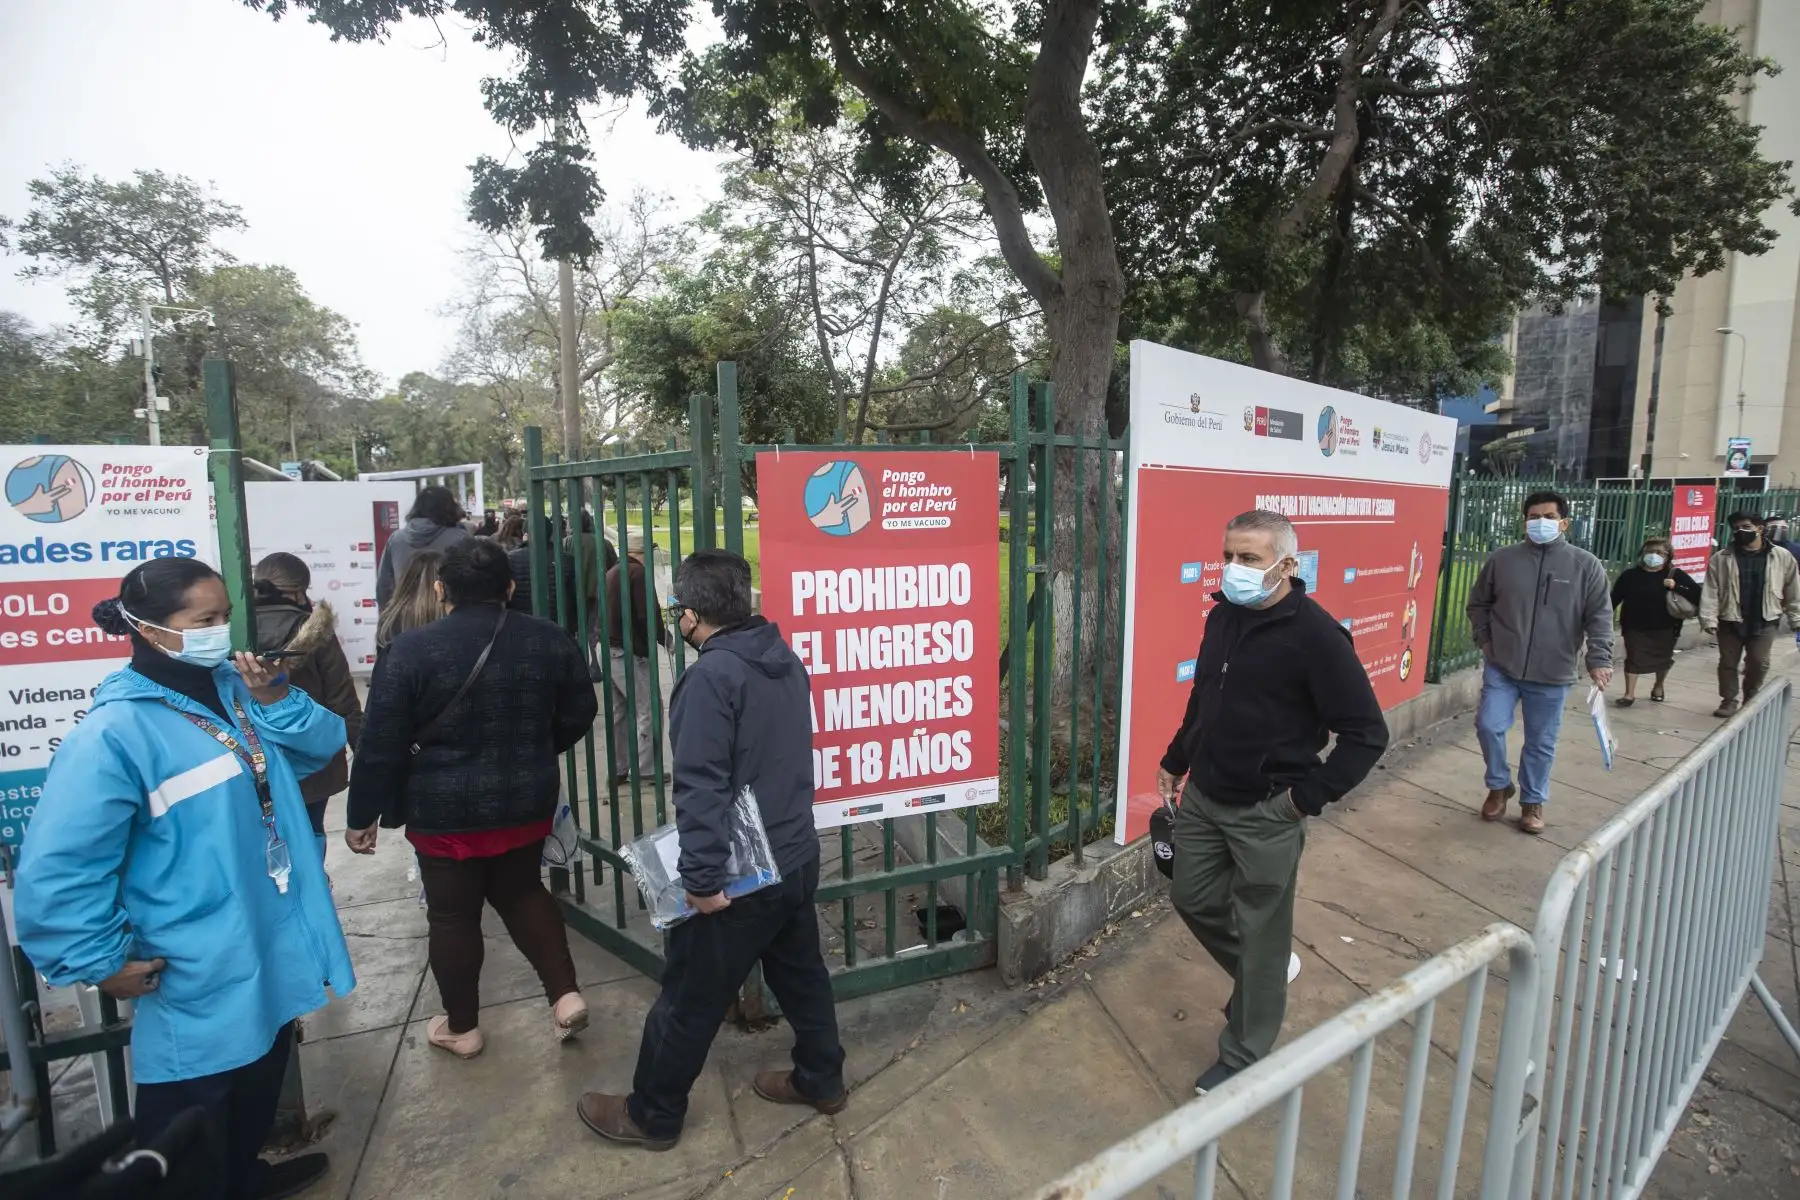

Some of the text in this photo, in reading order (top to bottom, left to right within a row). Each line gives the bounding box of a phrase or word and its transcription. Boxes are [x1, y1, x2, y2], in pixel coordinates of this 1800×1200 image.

[1164, 411, 1223, 431] Gobierno del Perú
[101, 463, 153, 477] Pongo
[882, 469, 926, 486] Pongo
[102, 475, 186, 488] el hombro
[101, 488, 192, 505] por el Perú
[883, 483, 952, 498] el hombro
[124, 507, 138, 515] ME
[143, 507, 181, 515] VACUNO
[882, 497, 957, 516] por el Perú
[887, 519, 947, 528] YO ME VACUNO
[0, 536, 197, 565] ades raras
[1204, 561, 1220, 571] Acude
[791, 562, 971, 616] PROHIBIDO
[1203, 576, 1216, 587] boca
[0, 593, 69, 617] OLO
[791, 619, 974, 675] EL INGRESO
[9, 688, 86, 705] Videna
[824, 675, 973, 731] MENORES
[846, 740, 883, 788] 18
[888, 727, 972, 781] AÑOS
